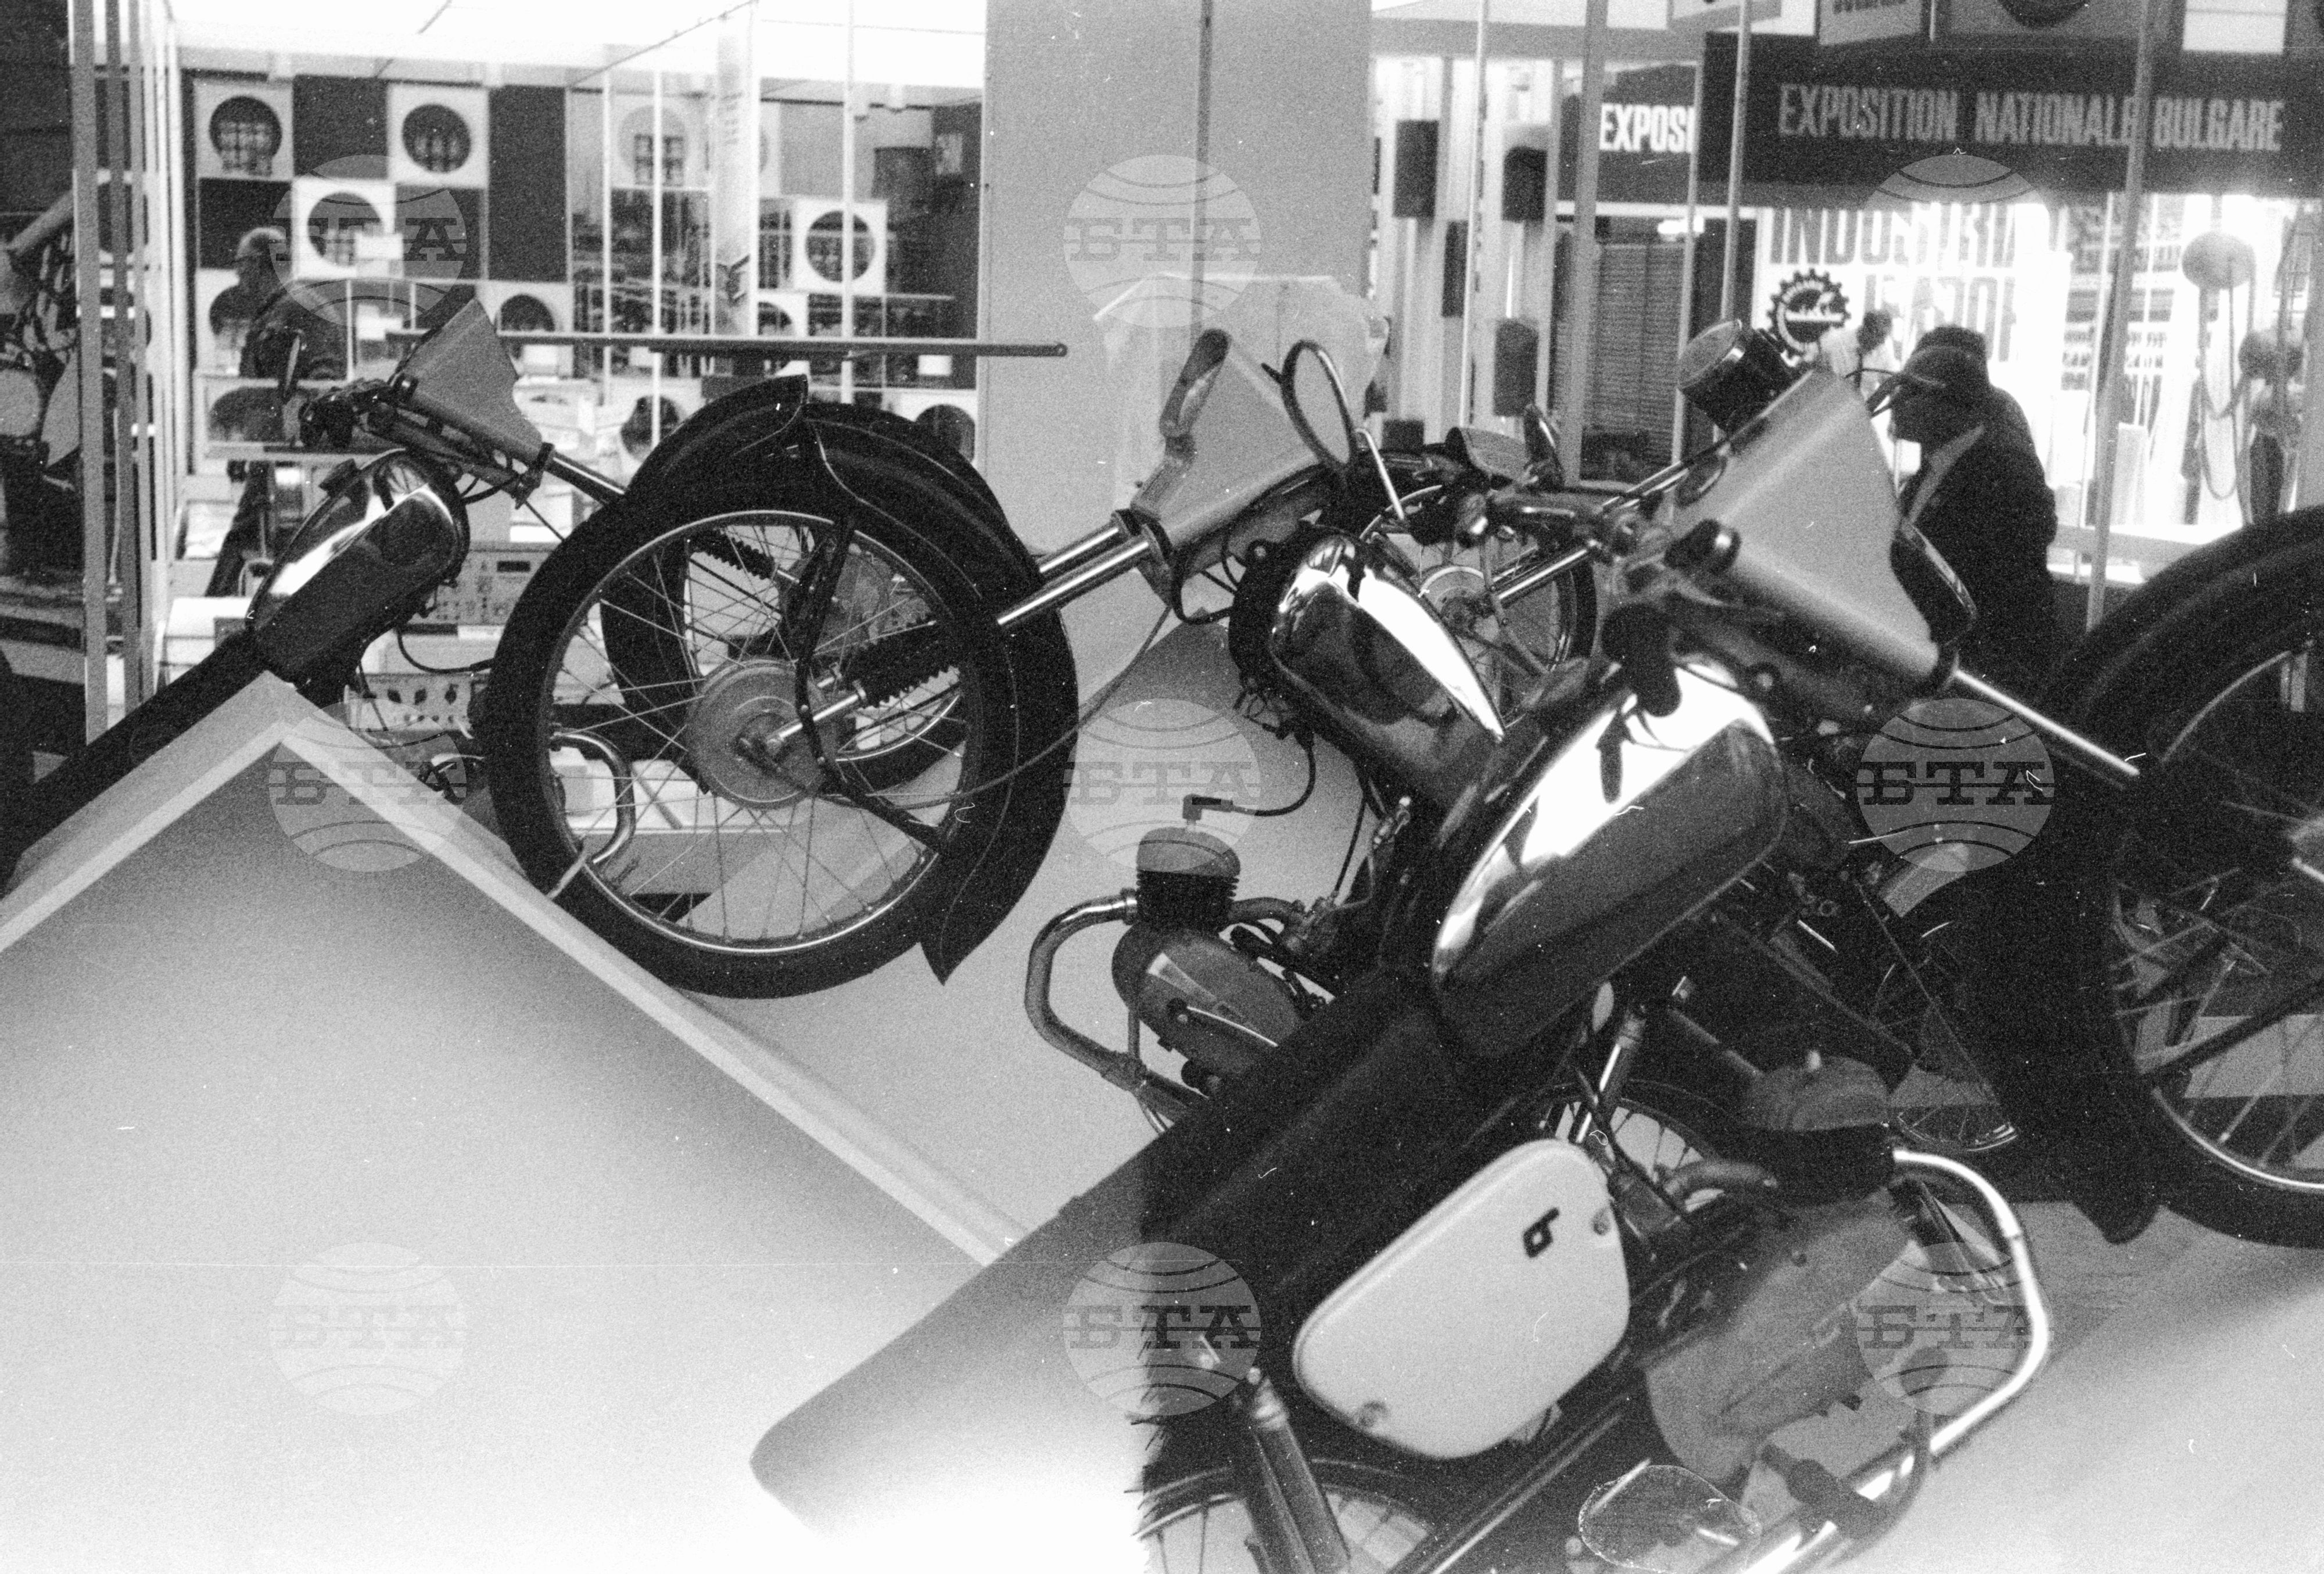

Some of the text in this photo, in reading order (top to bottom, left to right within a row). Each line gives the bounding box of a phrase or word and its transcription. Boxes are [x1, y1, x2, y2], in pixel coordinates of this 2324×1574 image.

[1599, 103, 1695, 153] EXPOSI
[1778, 83, 1958, 141] EXPOSITION
[2153, 96, 2284, 152] BULGARE
